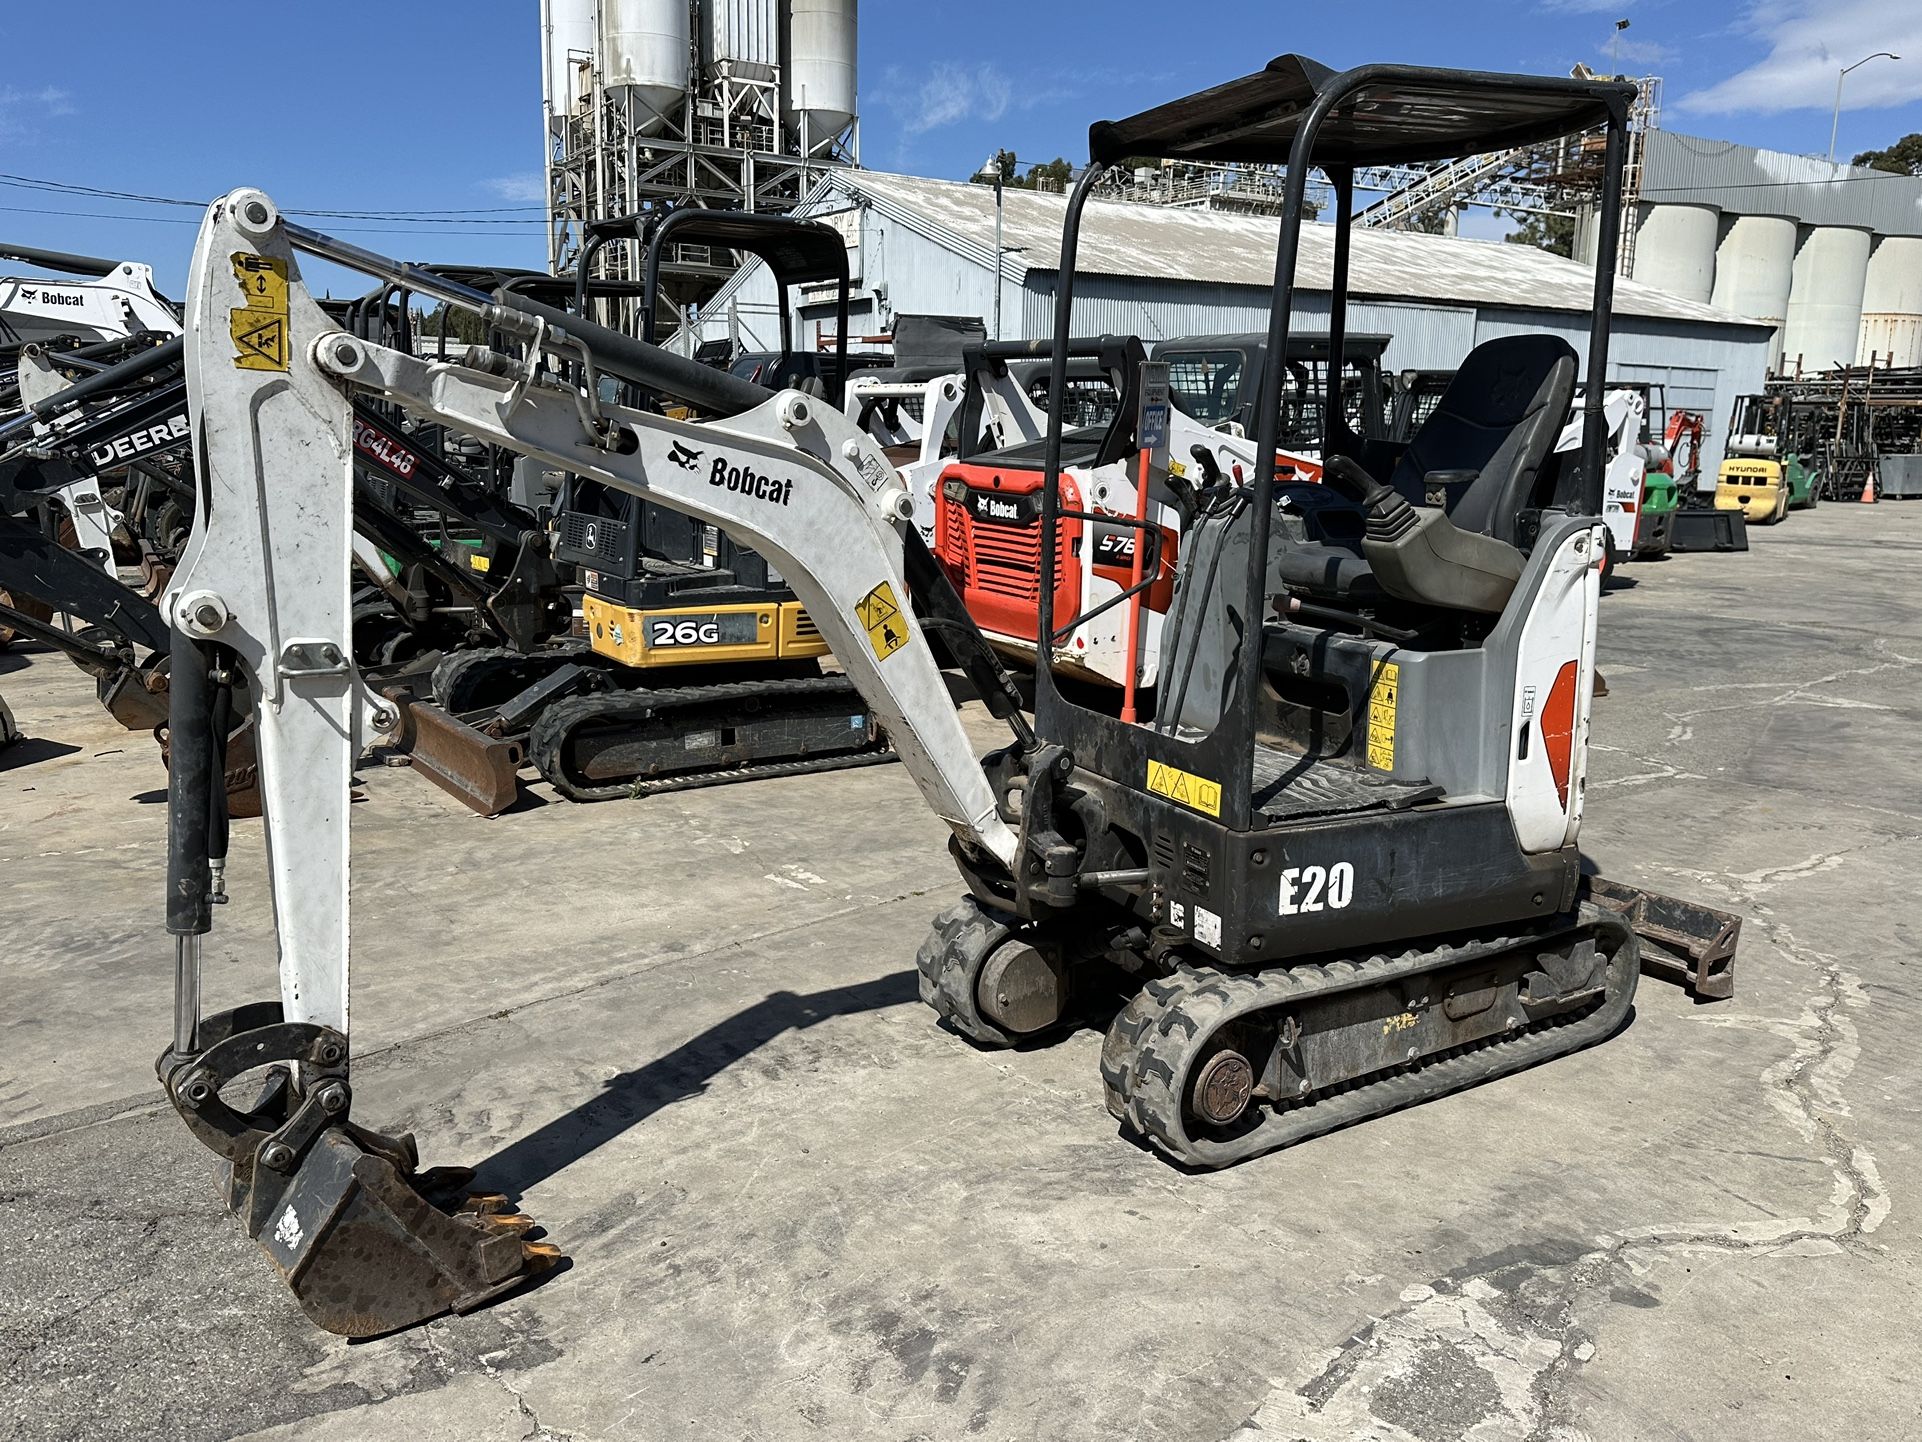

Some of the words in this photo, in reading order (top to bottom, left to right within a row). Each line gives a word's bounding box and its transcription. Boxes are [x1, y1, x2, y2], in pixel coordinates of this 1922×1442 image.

[41, 291, 85, 306] Bobcat
[1144, 410, 1164, 431] OFFICE
[91, 414, 190, 466] DEERE
[1728, 465, 1767, 473] HYUNDAI
[709, 457, 793, 506] Bobcat
[1616, 490, 1635, 499] Bobcat
[990, 500, 1017, 519] Bobcat
[652, 621, 719, 646] 26G
[1278, 861, 1354, 916] E20
